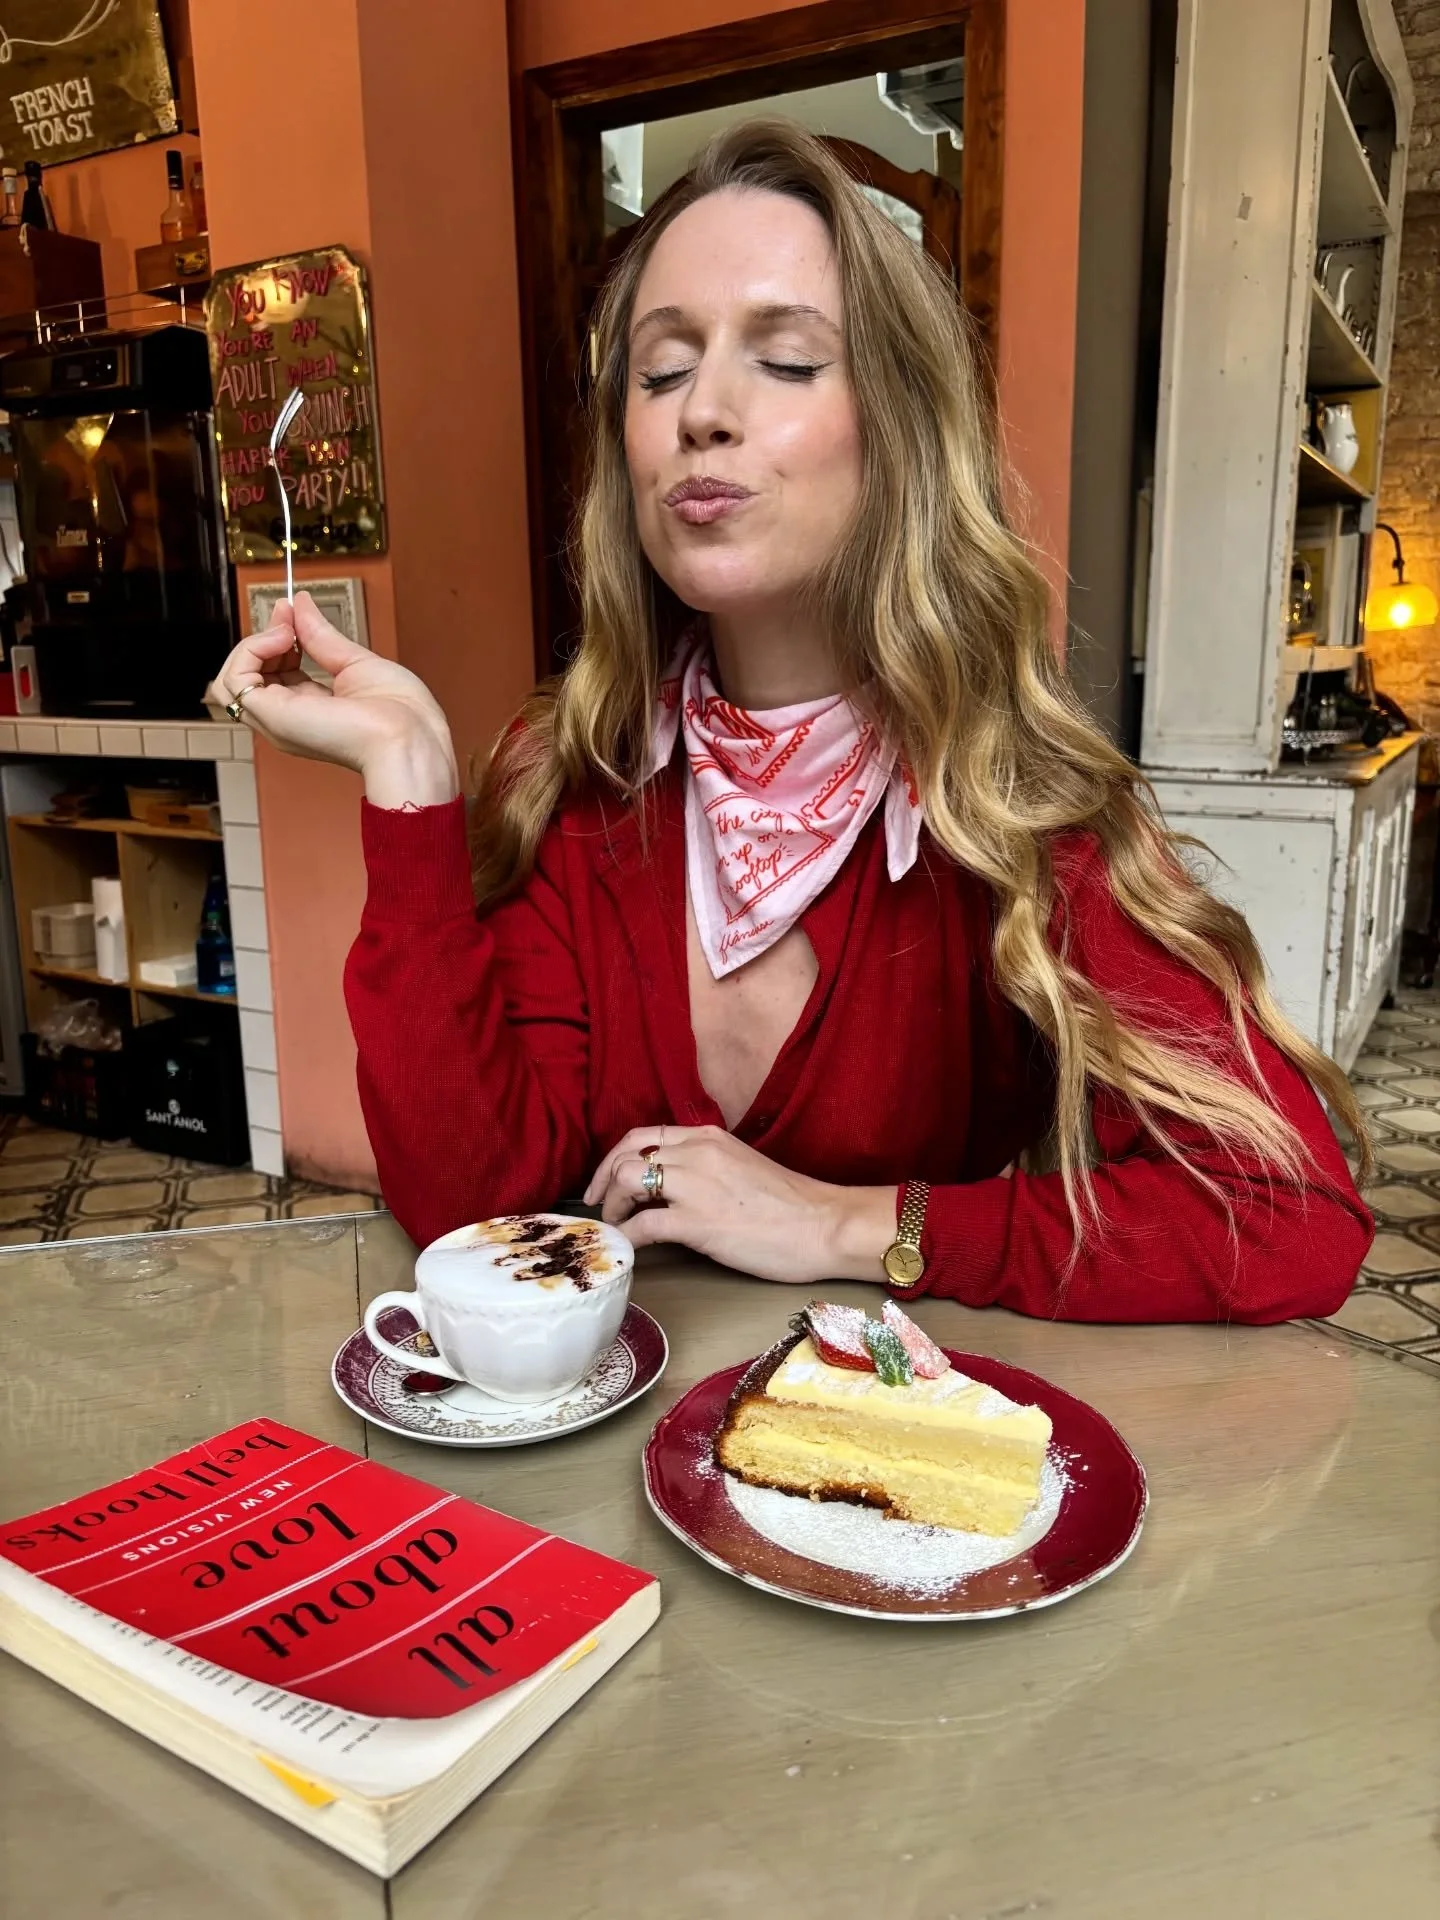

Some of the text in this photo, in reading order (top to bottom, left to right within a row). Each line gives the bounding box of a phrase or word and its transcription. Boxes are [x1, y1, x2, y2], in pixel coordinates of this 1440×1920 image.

[10, 77, 95, 123] FRENCH
[23, 111, 95, 149] TOAST
[216, 356, 279, 408] ADULT
[238, 409, 275, 433] YOU
[229, 485, 265, 511] YOU
[716, 808, 784, 836] the city
[731, 843, 753, 865] up
[758, 832, 778, 843] on
[785, 828, 797, 836] a
[5, 1433, 295, 1550] bell hooks
[121, 1479, 295, 1561] NEW VISIONS
[180, 1502, 362, 1589] love
[241, 1528, 459, 1659] about
[407, 1605, 515, 1690] all
